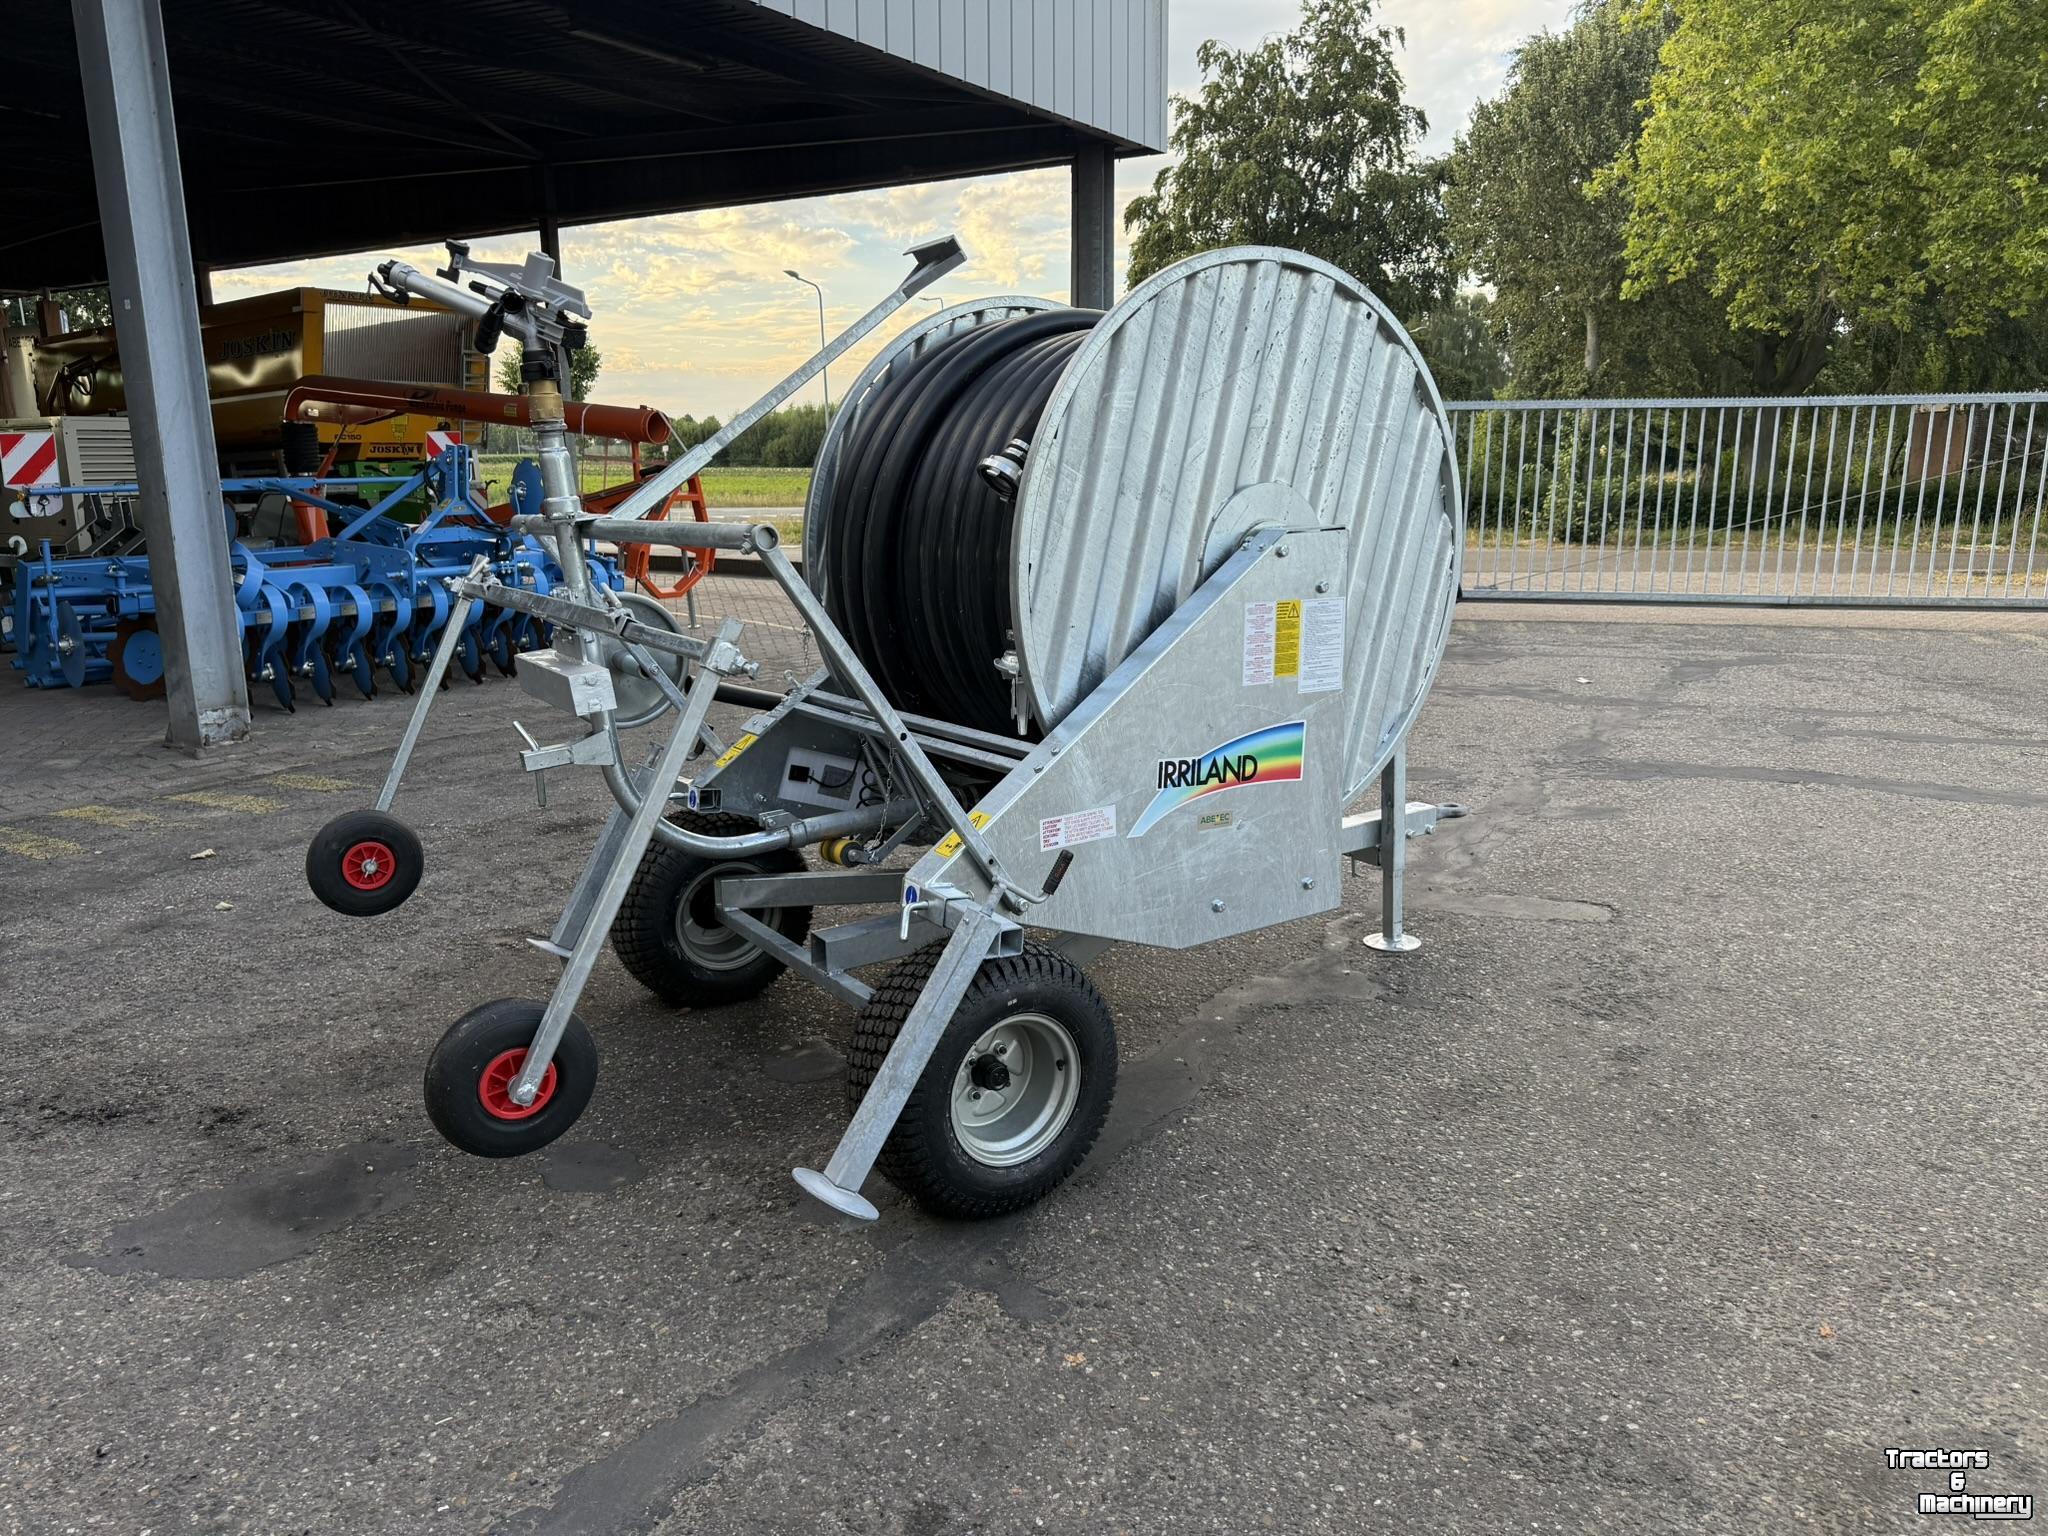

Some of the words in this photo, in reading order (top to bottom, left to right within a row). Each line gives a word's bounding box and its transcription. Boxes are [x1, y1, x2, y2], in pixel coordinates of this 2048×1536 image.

[220, 330, 297, 359] JOSKIN
[369, 445, 415, 455] JOSKIN
[1157, 755, 1258, 789] IRRILAND
